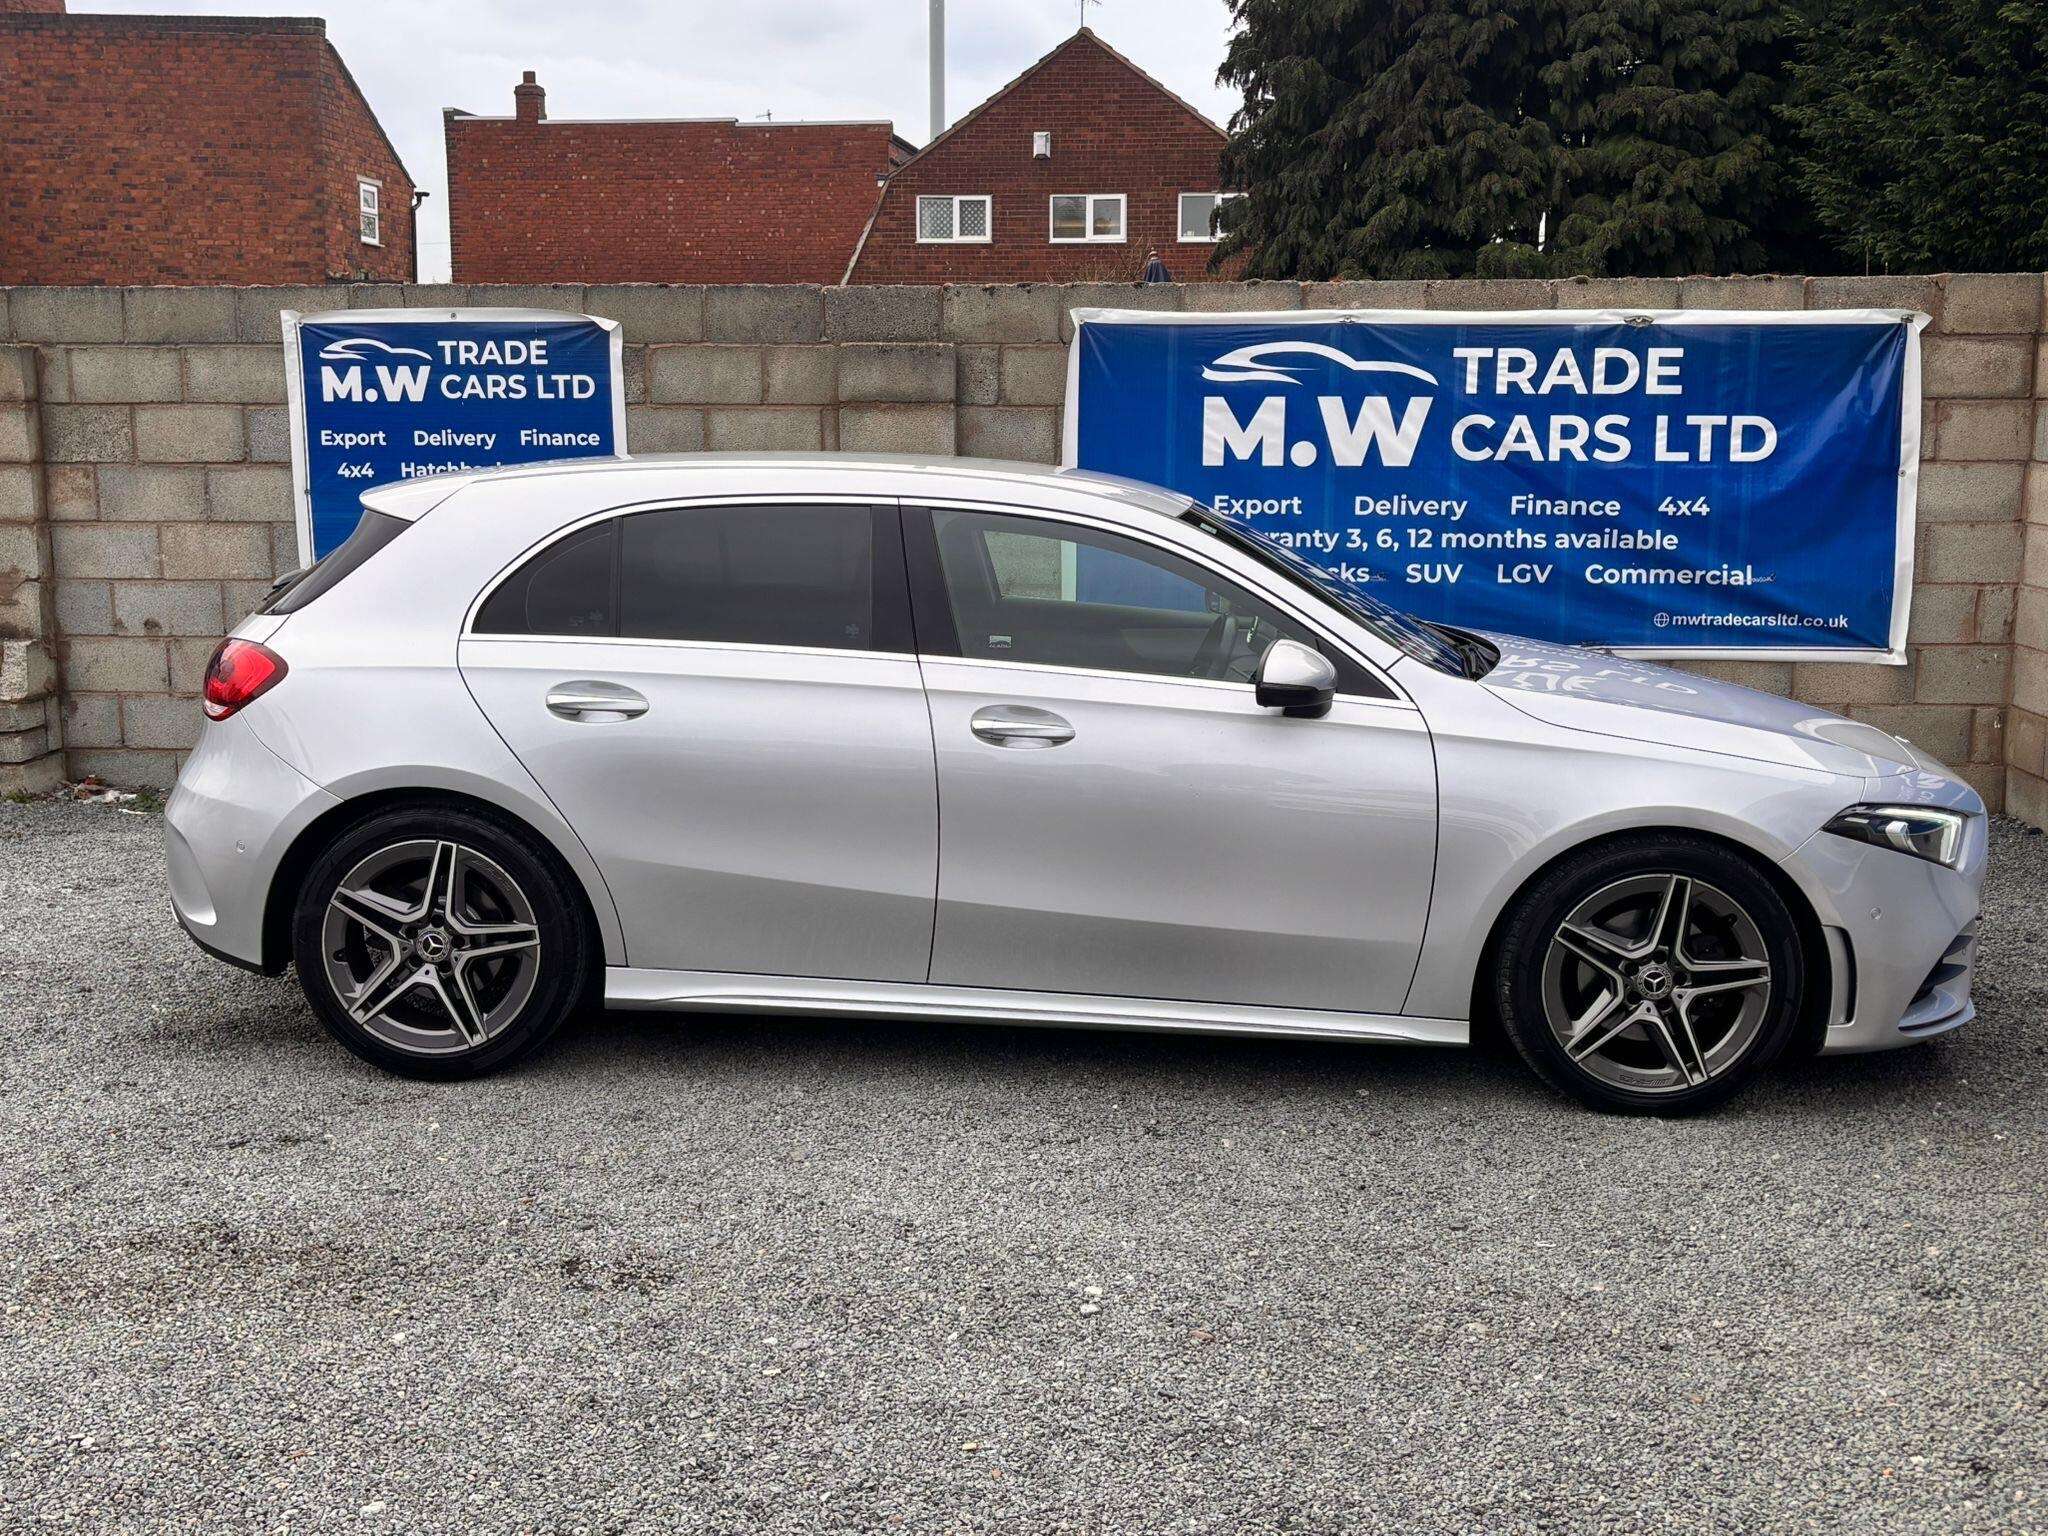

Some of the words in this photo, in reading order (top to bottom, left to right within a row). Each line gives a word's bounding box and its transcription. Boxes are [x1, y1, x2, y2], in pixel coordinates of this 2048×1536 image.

[437, 340, 549, 365] TRADE
[1452, 347, 1684, 395] TRADE
[320, 365, 431, 403] M.W
[440, 374, 527, 400] CARS
[536, 374, 596, 400] LTD
[320, 429, 387, 450] Export
[413, 428, 497, 450] Delivery
[520, 428, 600, 446] Finance
[1202, 395, 1434, 468] M.W
[1451, 413, 1632, 463] CARS
[1654, 414, 1778, 462] LTD
[337, 462, 375, 478] 4x4
[1214, 495, 1303, 519] Export
[1354, 495, 1468, 521] Delivery
[1510, 493, 1621, 517] Finance
[1657, 496, 1711, 517] 4x4
[1346, 528, 1368, 552] 3,
[1376, 528, 1400, 552] 6,
[1406, 528, 1433, 548] 12
[1441, 528, 1548, 550] months
[1554, 528, 1680, 551] available
[1406, 563, 1464, 584] SUV
[1497, 563, 1553, 585] LGV
[1585, 563, 1754, 586] Commercial
[1672, 612, 1849, 629] mwtradecarsltd.co.uk
